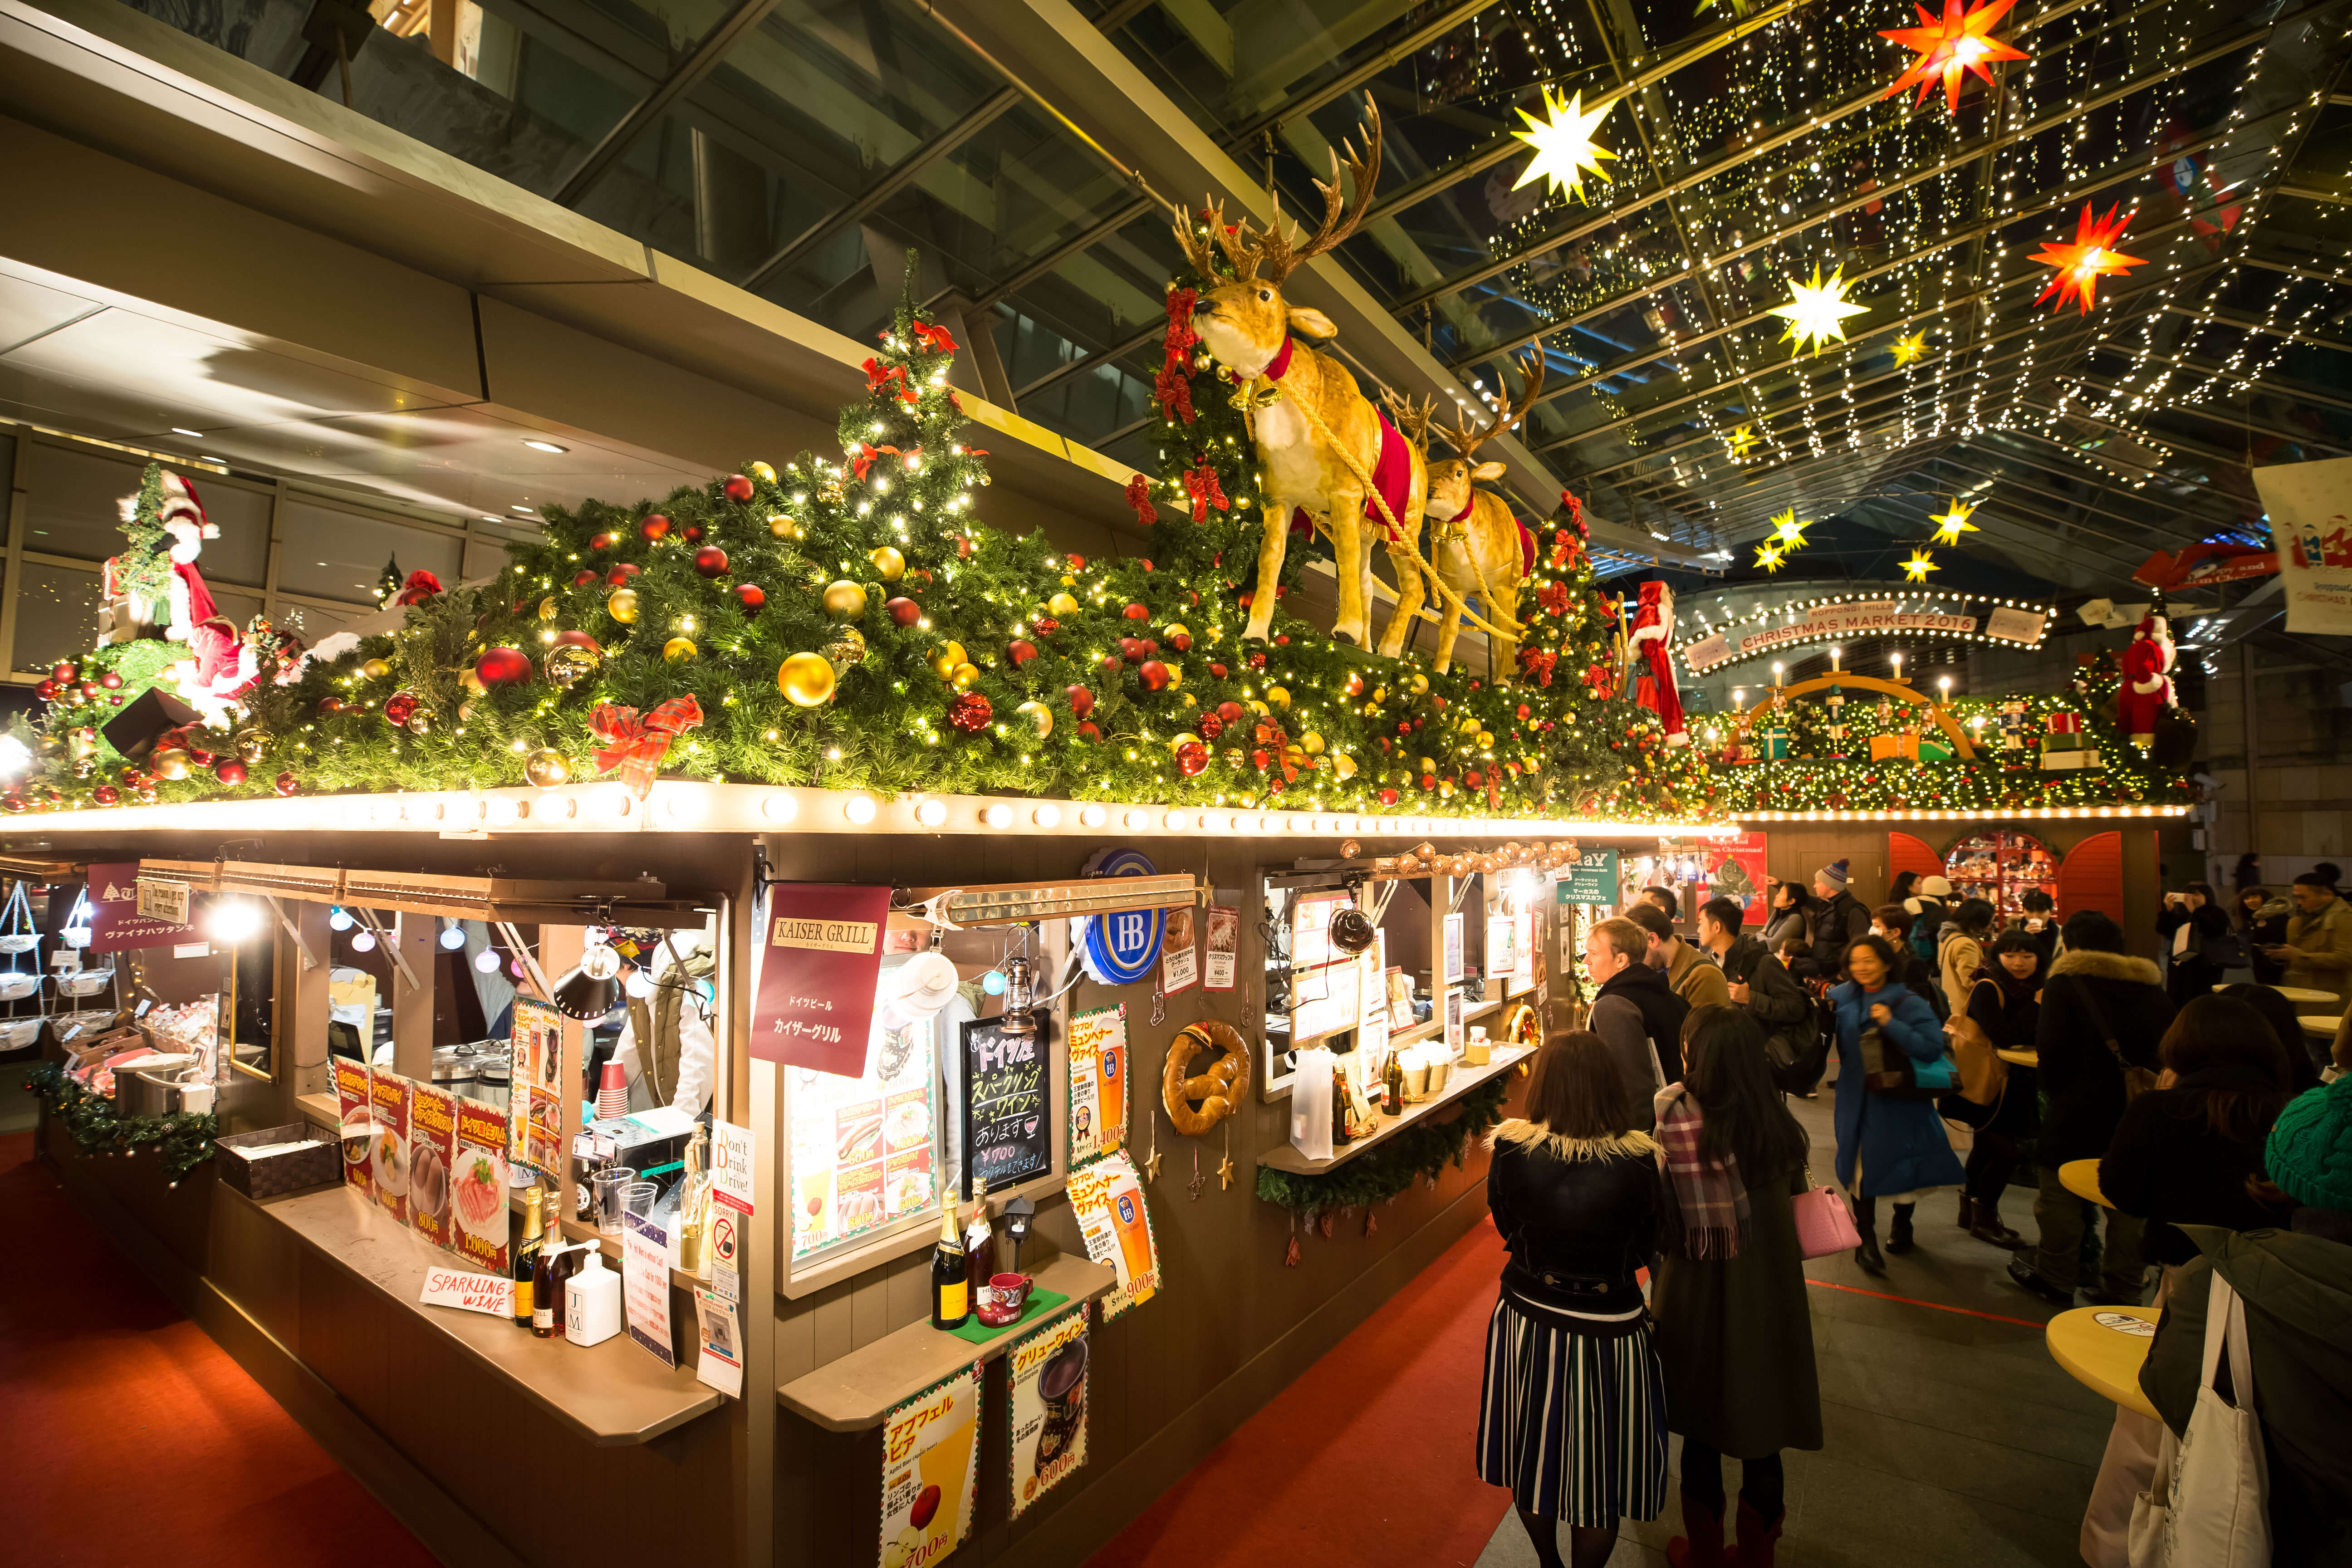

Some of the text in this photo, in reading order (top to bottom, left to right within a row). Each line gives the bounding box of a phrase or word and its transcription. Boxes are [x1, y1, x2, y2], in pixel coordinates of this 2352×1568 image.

[1812, 605, 1860, 617] ROPPONGI
[1743, 615, 1971, 648] CHRISTMAS MARKET 2016
[105, 924, 195, 939] ヴァイナハツタンネ
[778, 921, 870, 944] KAISER GRILL
[1118, 914, 1145, 952] HB
[1166, 949, 1194, 964] とろける黒毛和牛の
[1171, 957, 1189, 968] グーラッシュ
[1173, 966, 1189, 978] ¥1,000
[789, 995, 832, 1011] ドイツビール
[774, 1018, 841, 1043] カイザーグリル
[1069, 1020, 1094, 1034] ホフブロイ
[1070, 1027, 1113, 1048] ミュンヘナー
[980, 1032, 1035, 1073] ドイツ産
[1071, 1044, 1101, 1062] ヴァイス
[1107, 1062, 1114, 1074] HB
[372, 1081, 402, 1105] アップルパイ
[972, 1065, 1042, 1103] スパークリング
[1073, 1089, 1090, 1098] 小麦の香り
[415, 1091, 445, 1111] ミュンヘナー
[996, 1094, 1031, 1118] ワイン
[461, 1115, 485, 1137] ドイツ産
[485, 1122, 506, 1144] 生ハム
[975, 1118, 1023, 1147] あります
[1093, 1126, 1125, 1150] 1,400円
[720, 1129, 747, 1156] Don't
[893, 1134, 923, 1151] 1,000円
[1077, 1142, 1092, 1154] Mサイズ
[716, 1143, 747, 1175] Drink
[848, 1150, 874, 1165] 600円
[887, 1151, 919, 1168] アップルパイ
[981, 1146, 1015, 1166] ¥700
[838, 1166, 872, 1181] ミュンヘナー
[979, 1154, 1037, 1181] カクテルもできます
[720, 1167, 748, 1193] Drive!
[1067, 1171, 1095, 1187] ホフブロイ
[1071, 1173, 1121, 1202] ミュンヘナー
[382, 1188, 397, 1209] 600円
[898, 1194, 922, 1211] 600円
[1076, 1191, 1111, 1216] ヴァイス
[419, 1211, 438, 1234] 800円
[715, 1205, 735, 1220] SORRY!
[847, 1211, 874, 1229] 800円
[1122, 1207, 1132, 1220] HB
[465, 1233, 497, 1260] 1,000円
[801, 1230, 828, 1247] 700円
[1091, 1240, 1110, 1253] 小麦の香り
[429, 1274, 506, 1295] SPARKLING
[1127, 1273, 1155, 1298] 900円
[463, 1295, 505, 1313] WINE
[570, 1294, 577, 1308] J
[1112, 1292, 1127, 1307] Sサイズ
[569, 1314, 580, 1330] M
[1017, 1321, 1085, 1372] グリューワイン
[891, 1395, 953, 1445] アプフェル
[1016, 1423, 1039, 1444] 冬の風物詩
[889, 1441, 938, 1475] Apfel Bier (Apple beer)
[891, 1435, 916, 1463] ビア
[1040, 1454, 1075, 1487] 600円
[887, 1481, 923, 1511] 程よい香りが
[888, 1481, 911, 1501] リンゴの
[886, 1494, 916, 1519] 女性に人気
[904, 1533, 948, 1568] 700円
